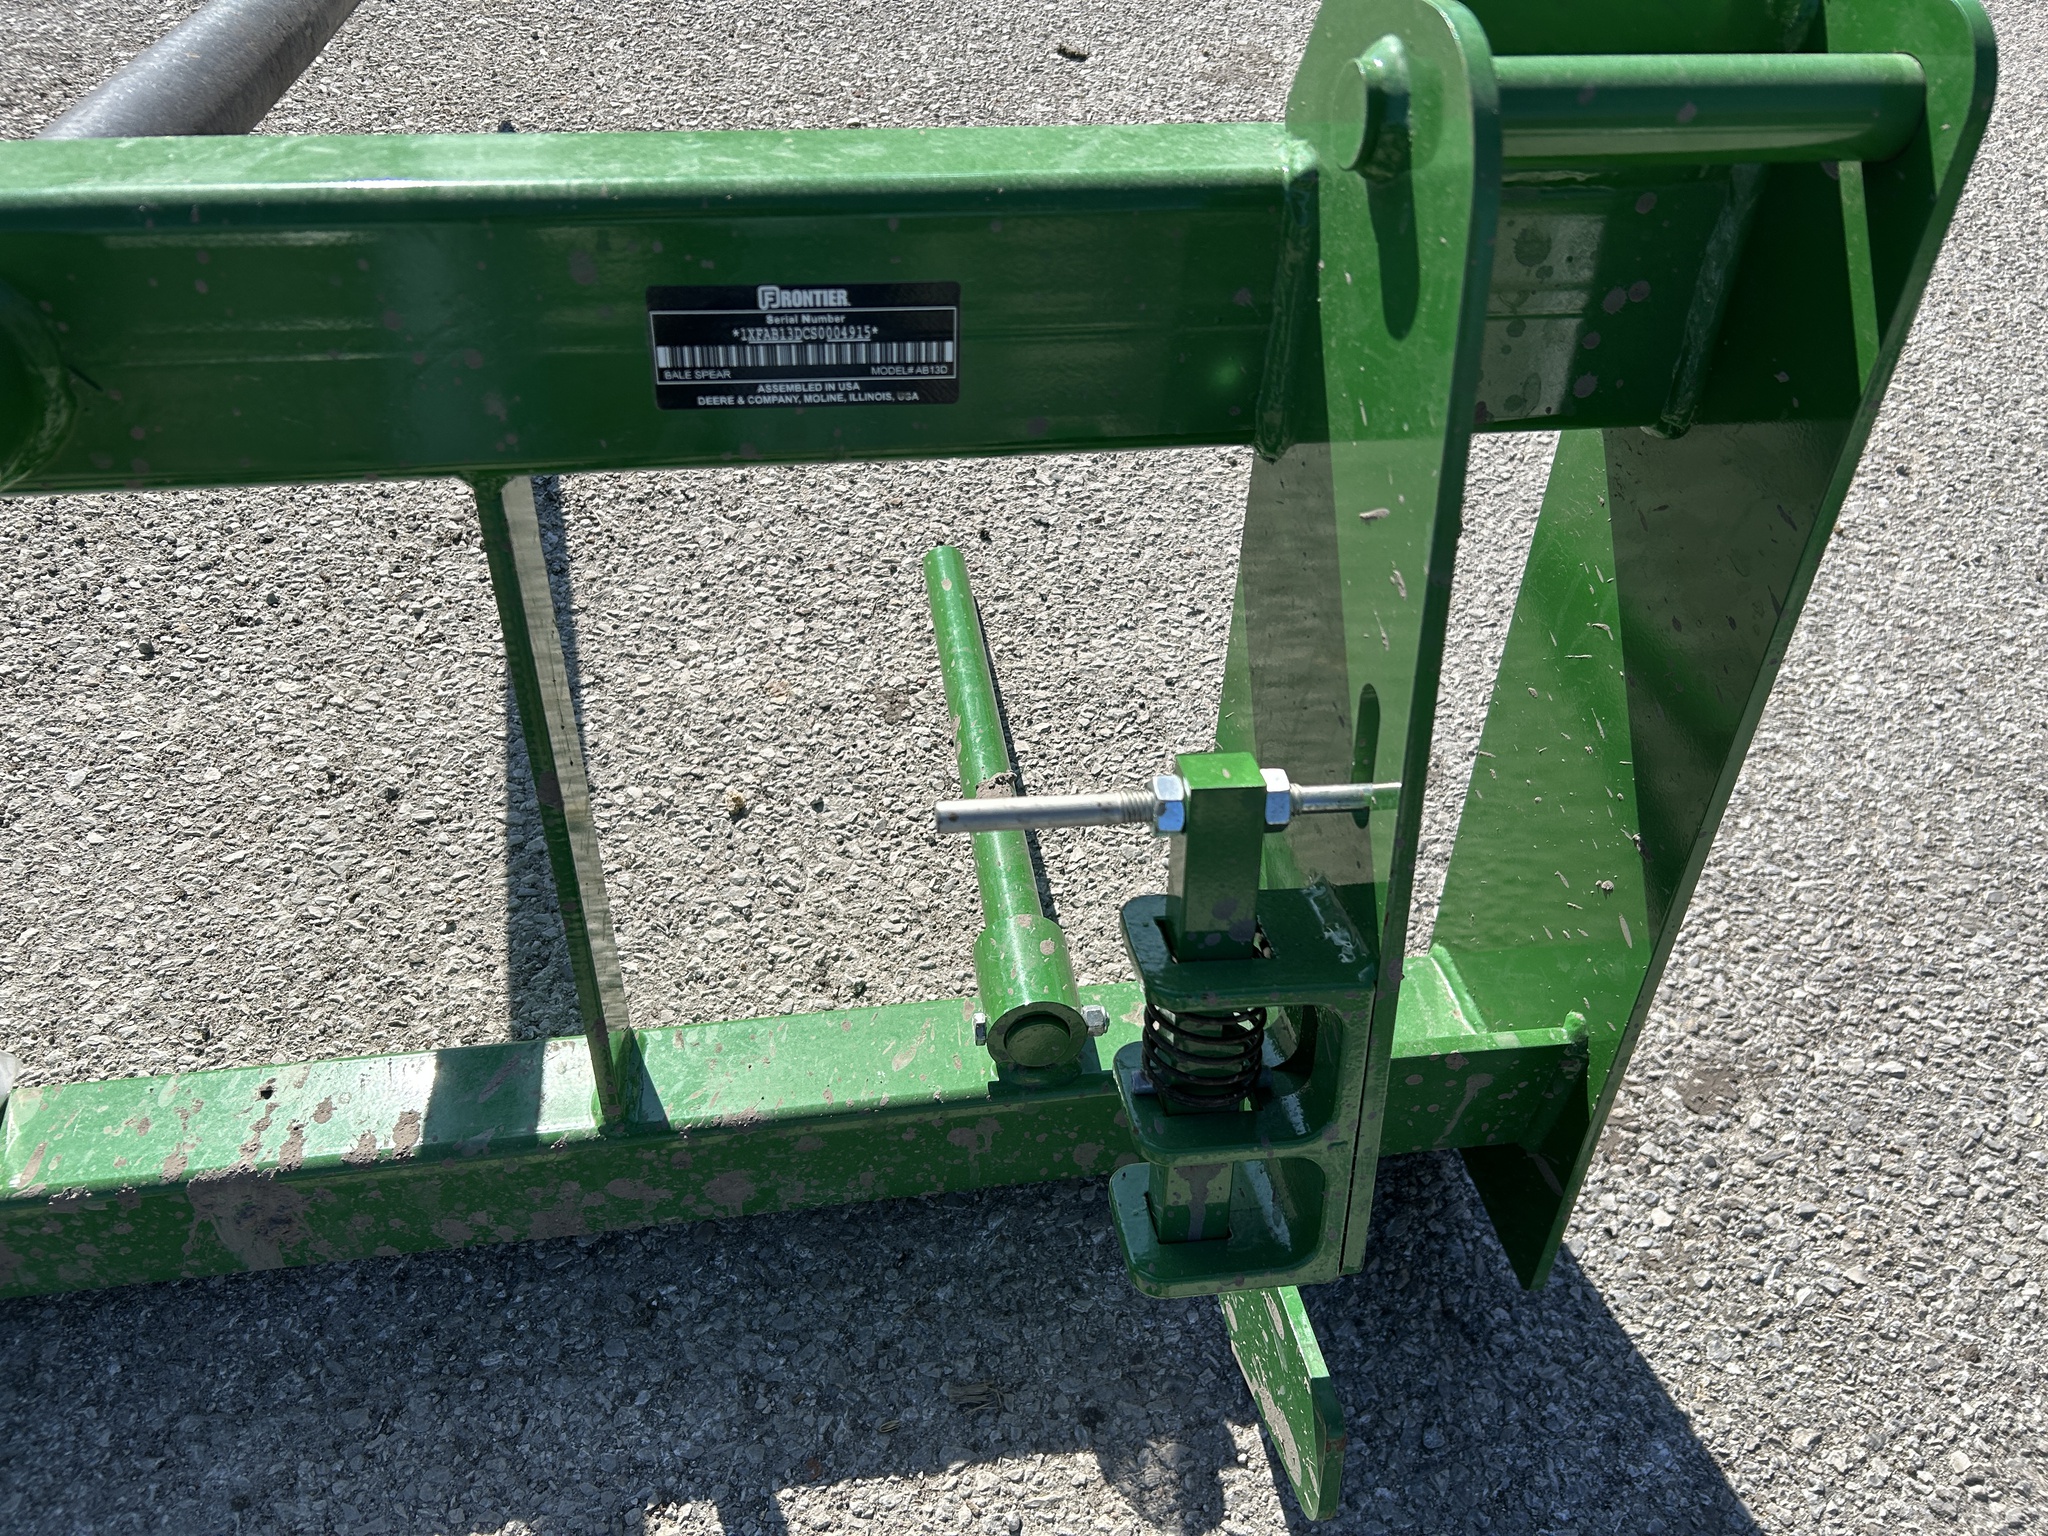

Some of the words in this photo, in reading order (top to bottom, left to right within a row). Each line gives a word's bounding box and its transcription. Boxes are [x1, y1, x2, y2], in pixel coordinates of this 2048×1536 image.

[765, 314, 798, 324] Serial
[801, 314, 846, 323] Number
[664, 370, 692, 379] BALE
[694, 369, 731, 379] SPEAR
[871, 366, 914, 375] MODEL#
[916, 365, 948, 374] AB13D
[757, 383, 822, 393] ASSEMBLED
[825, 382, 836, 391] IN
[838, 382, 860, 391] USA
[697, 396, 735, 405] DEERE
[737, 395, 745, 405] &
[747, 394, 801, 405] COMPANY,
[804, 393, 847, 403] MOLINE,
[849, 392, 895, 402] ILLINOIS,
[897, 391, 919, 401] USA
